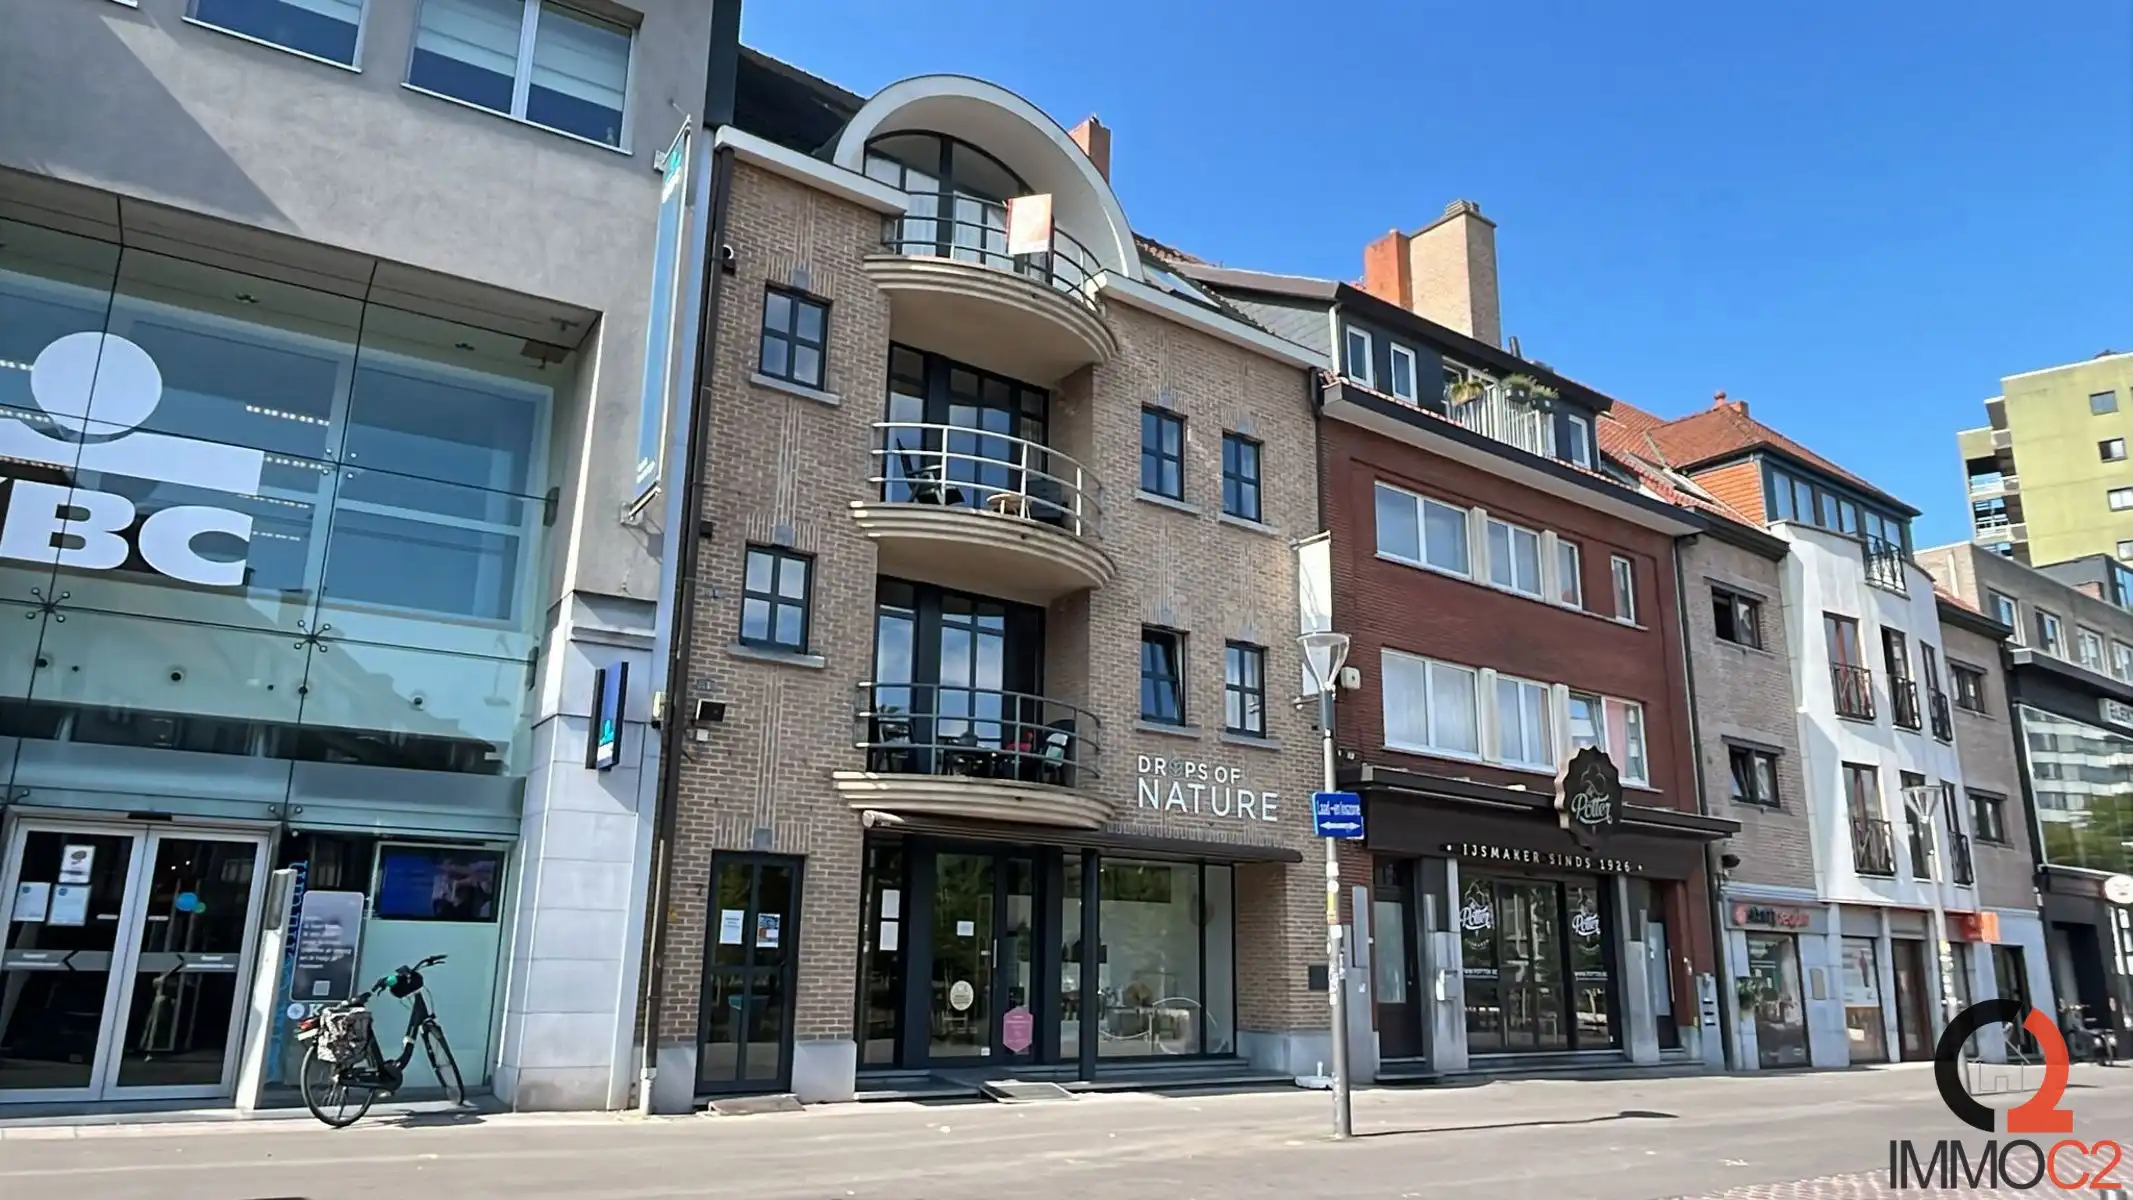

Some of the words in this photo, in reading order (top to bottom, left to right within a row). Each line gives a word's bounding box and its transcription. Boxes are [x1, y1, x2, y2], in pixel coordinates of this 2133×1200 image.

[0, 477, 254, 587] BC
[1214, 766, 1241, 784] OF
[1138, 777, 1278, 822] NATURE
[1571, 792, 1613, 825] Potter
[1463, 843, 1540, 864] IJSMAKER
[1549, 854, 1591, 869] SINDS
[1600, 859, 1630, 873] 1926
